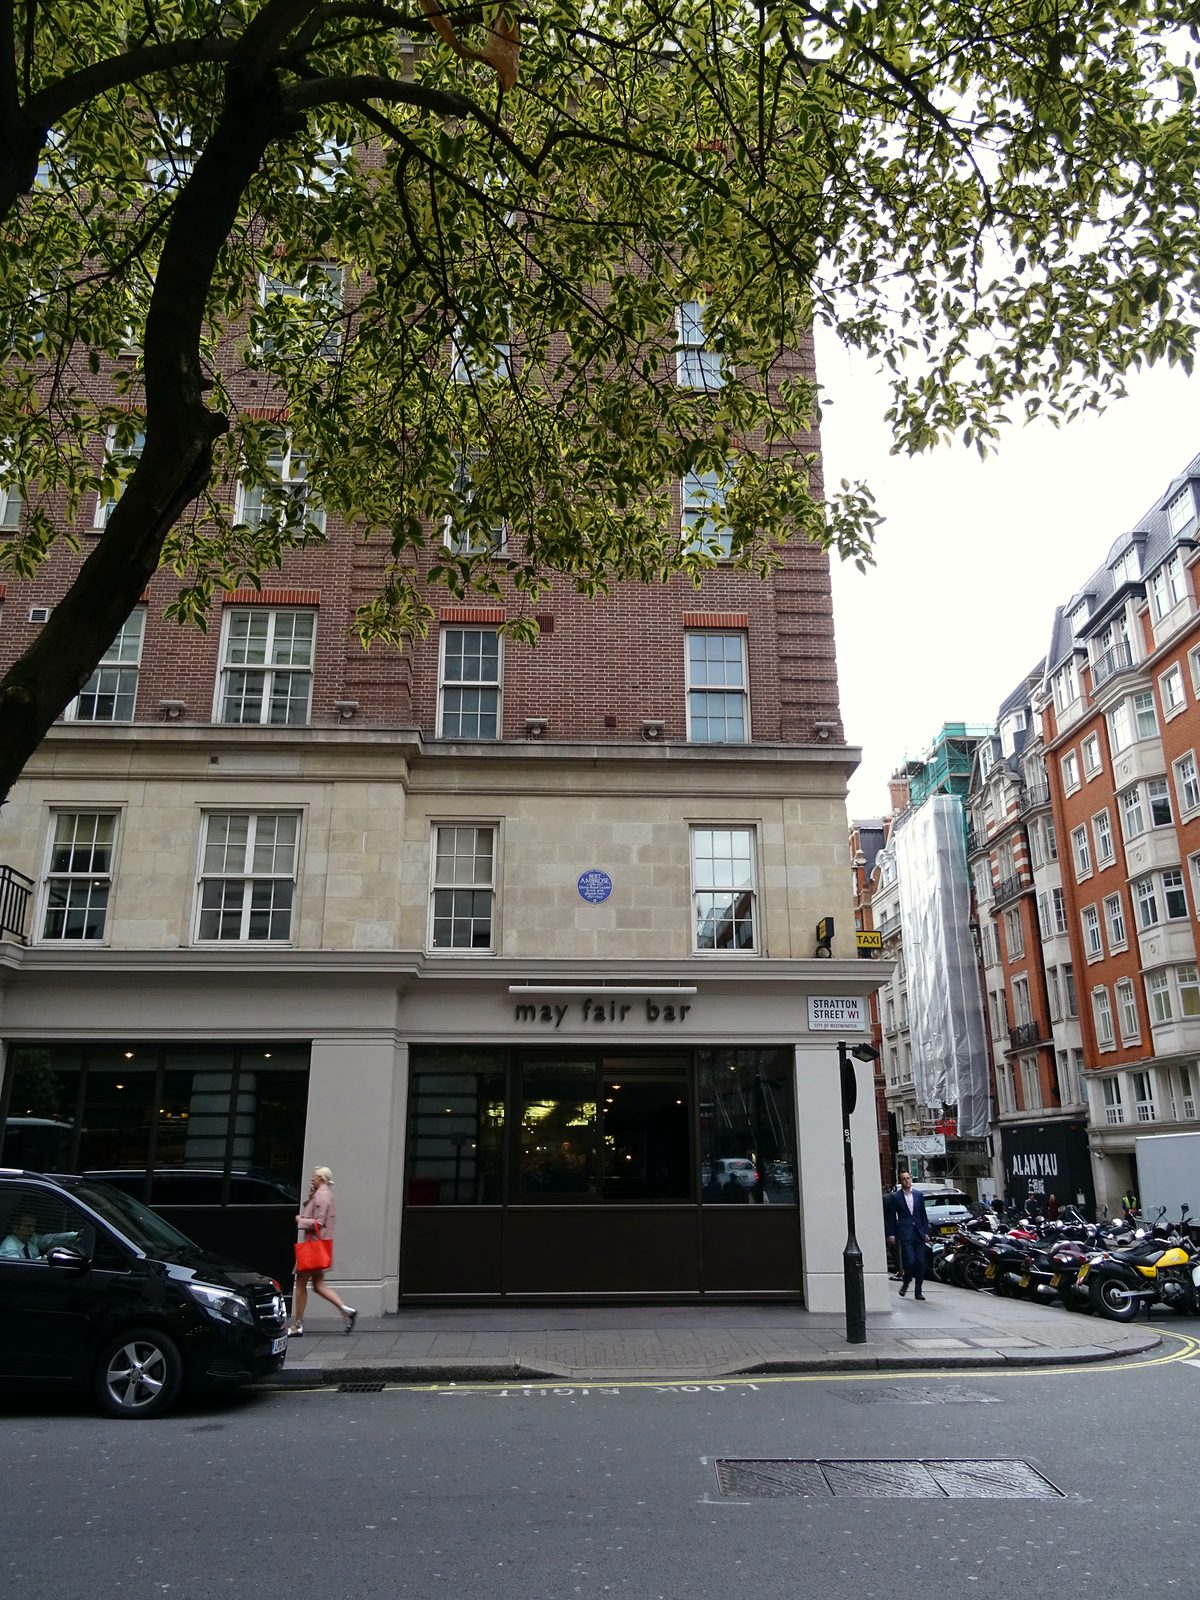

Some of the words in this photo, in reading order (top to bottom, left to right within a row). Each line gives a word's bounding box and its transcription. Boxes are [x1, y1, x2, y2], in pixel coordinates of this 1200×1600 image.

[856, 936, 879, 944] TAXI
[813, 1000, 857, 1009] STRATTON
[515, 1004, 568, 1028] may
[582, 998, 631, 1022] fair
[646, 998, 691, 1022] bar
[813, 1010, 844, 1019] STREET
[847, 1011, 859, 1019] W1
[1012, 1153, 1038, 1176] ALAN
[1037, 1153, 1058, 1176] YAU
[487, 1387, 620, 1397] RIGHT
[650, 1383, 760, 1393] LOOK
